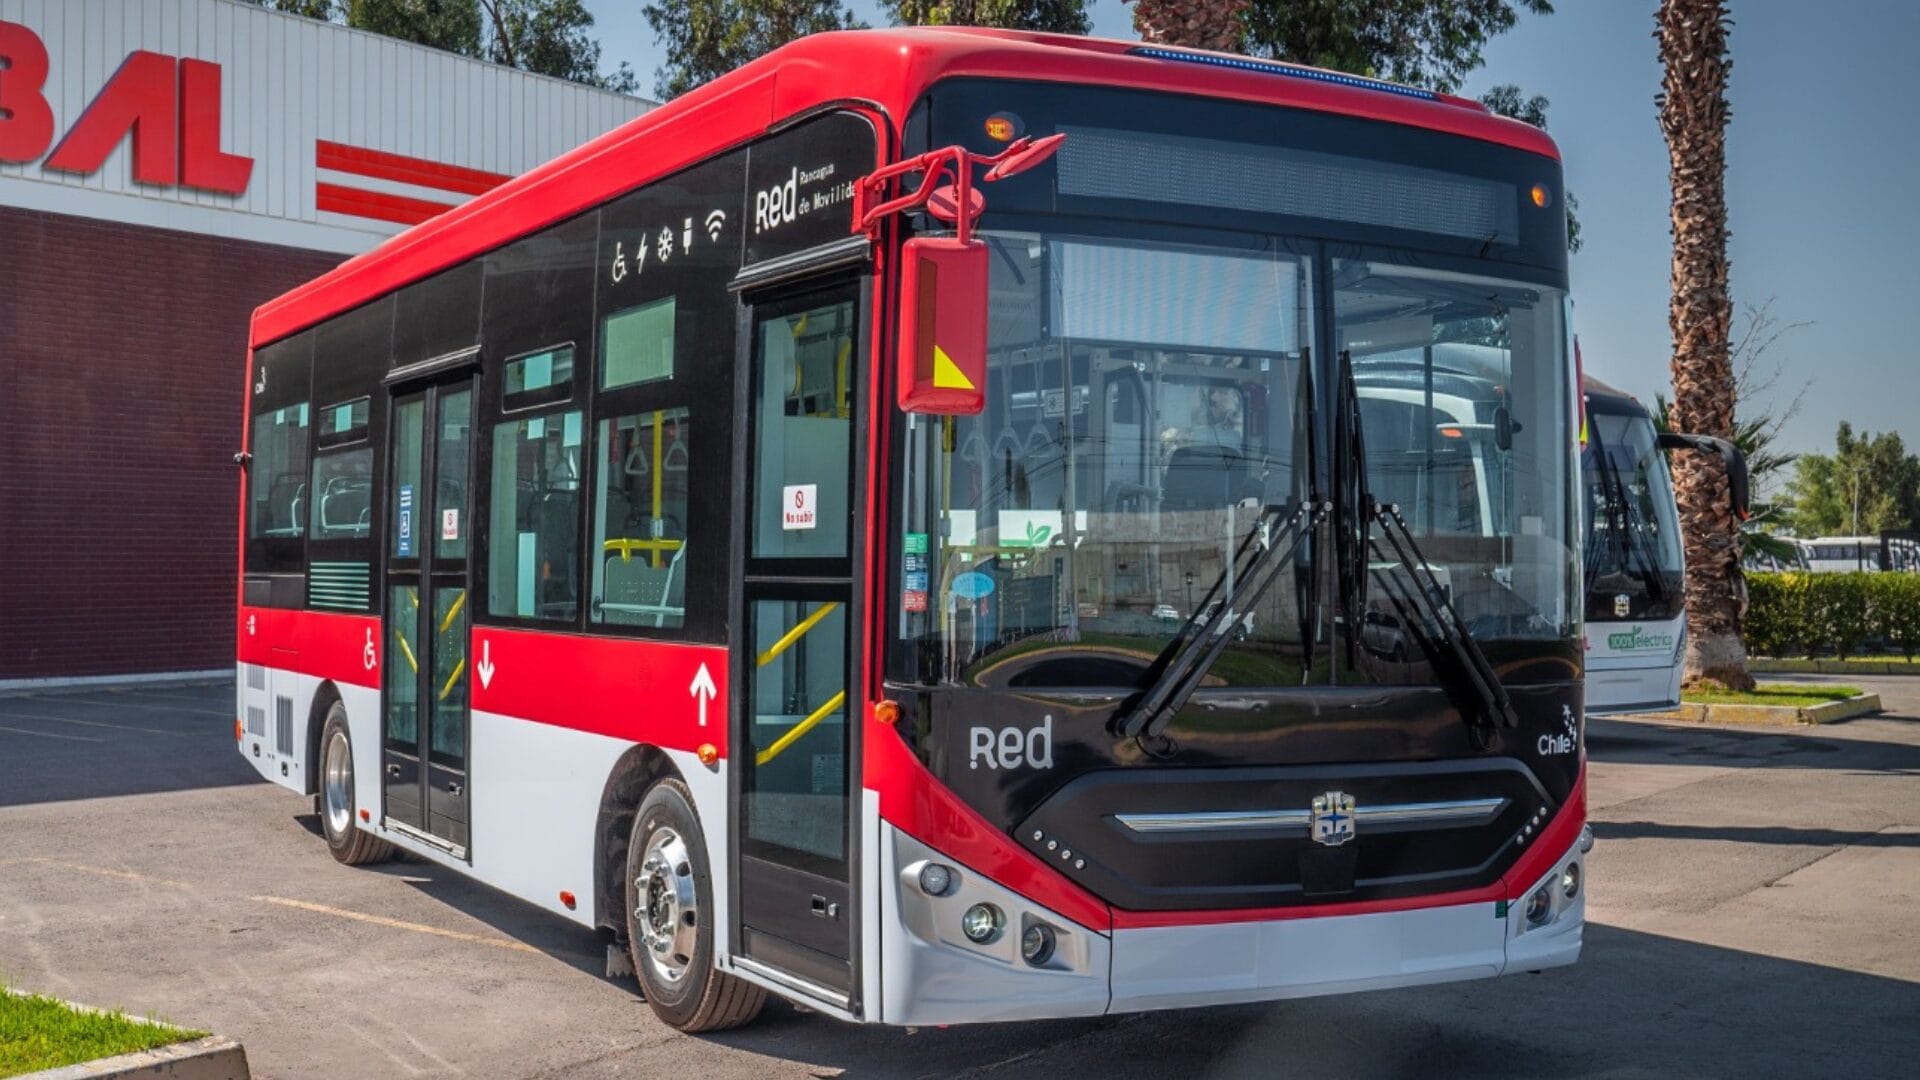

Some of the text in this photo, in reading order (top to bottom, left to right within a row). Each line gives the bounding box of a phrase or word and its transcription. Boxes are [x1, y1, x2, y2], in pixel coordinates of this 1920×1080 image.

[800, 163, 834, 185] Rancagua
[755, 166, 797, 234] Red
[799, 197, 810, 214] de
[786, 512, 795, 523] No
[969, 714, 1054, 769] Red
[1537, 733, 1571, 755] Chile
